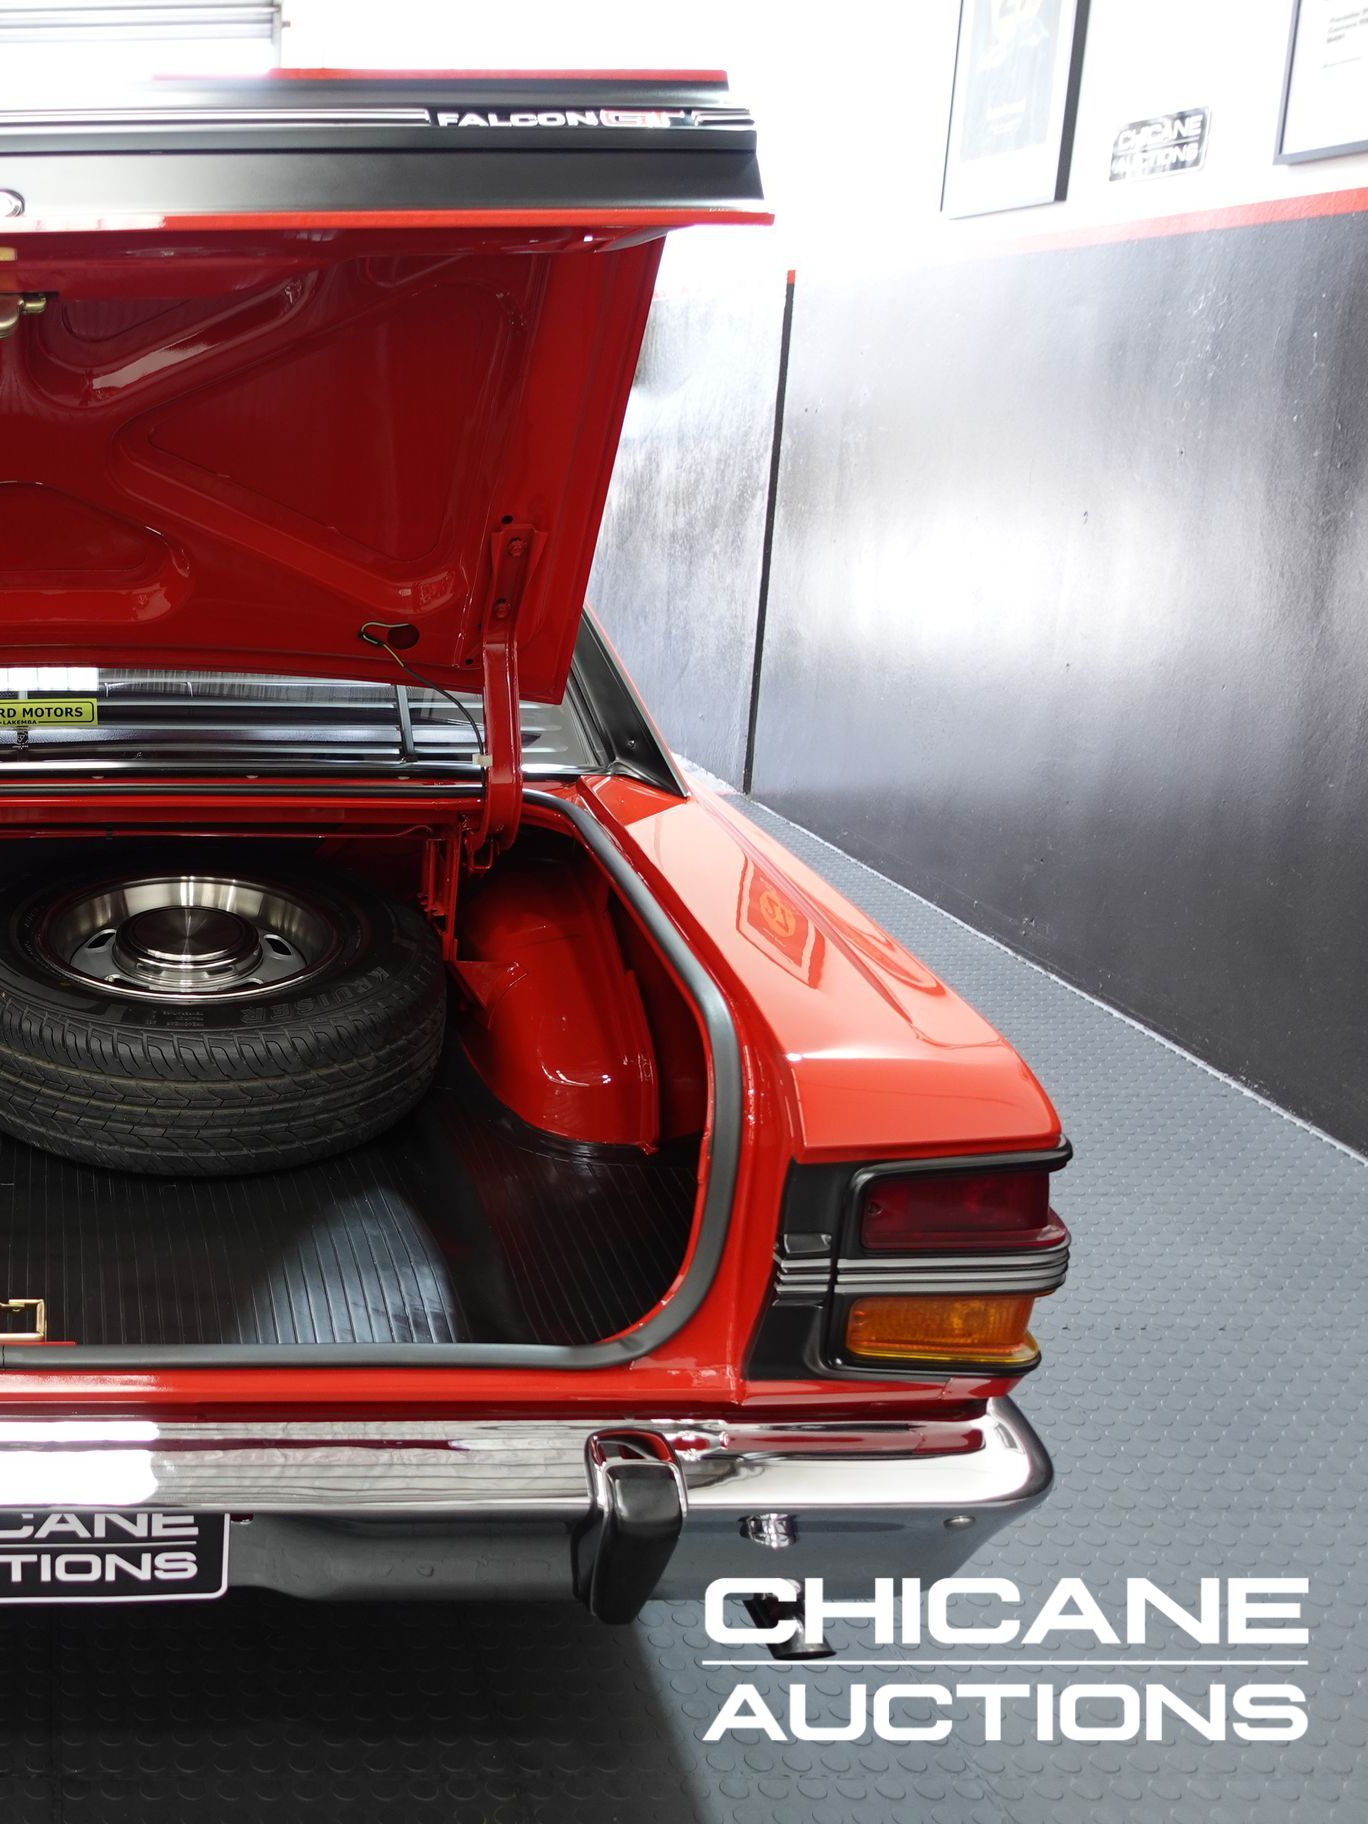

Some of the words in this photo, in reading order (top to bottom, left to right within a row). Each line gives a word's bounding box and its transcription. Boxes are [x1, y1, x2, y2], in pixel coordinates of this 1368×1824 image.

[437, 111, 599, 128] FALCON
[1117, 114, 1204, 153] CHICANE
[22, 706, 83, 718] MOTORS
[240, 966, 389, 1024] KRUISER
